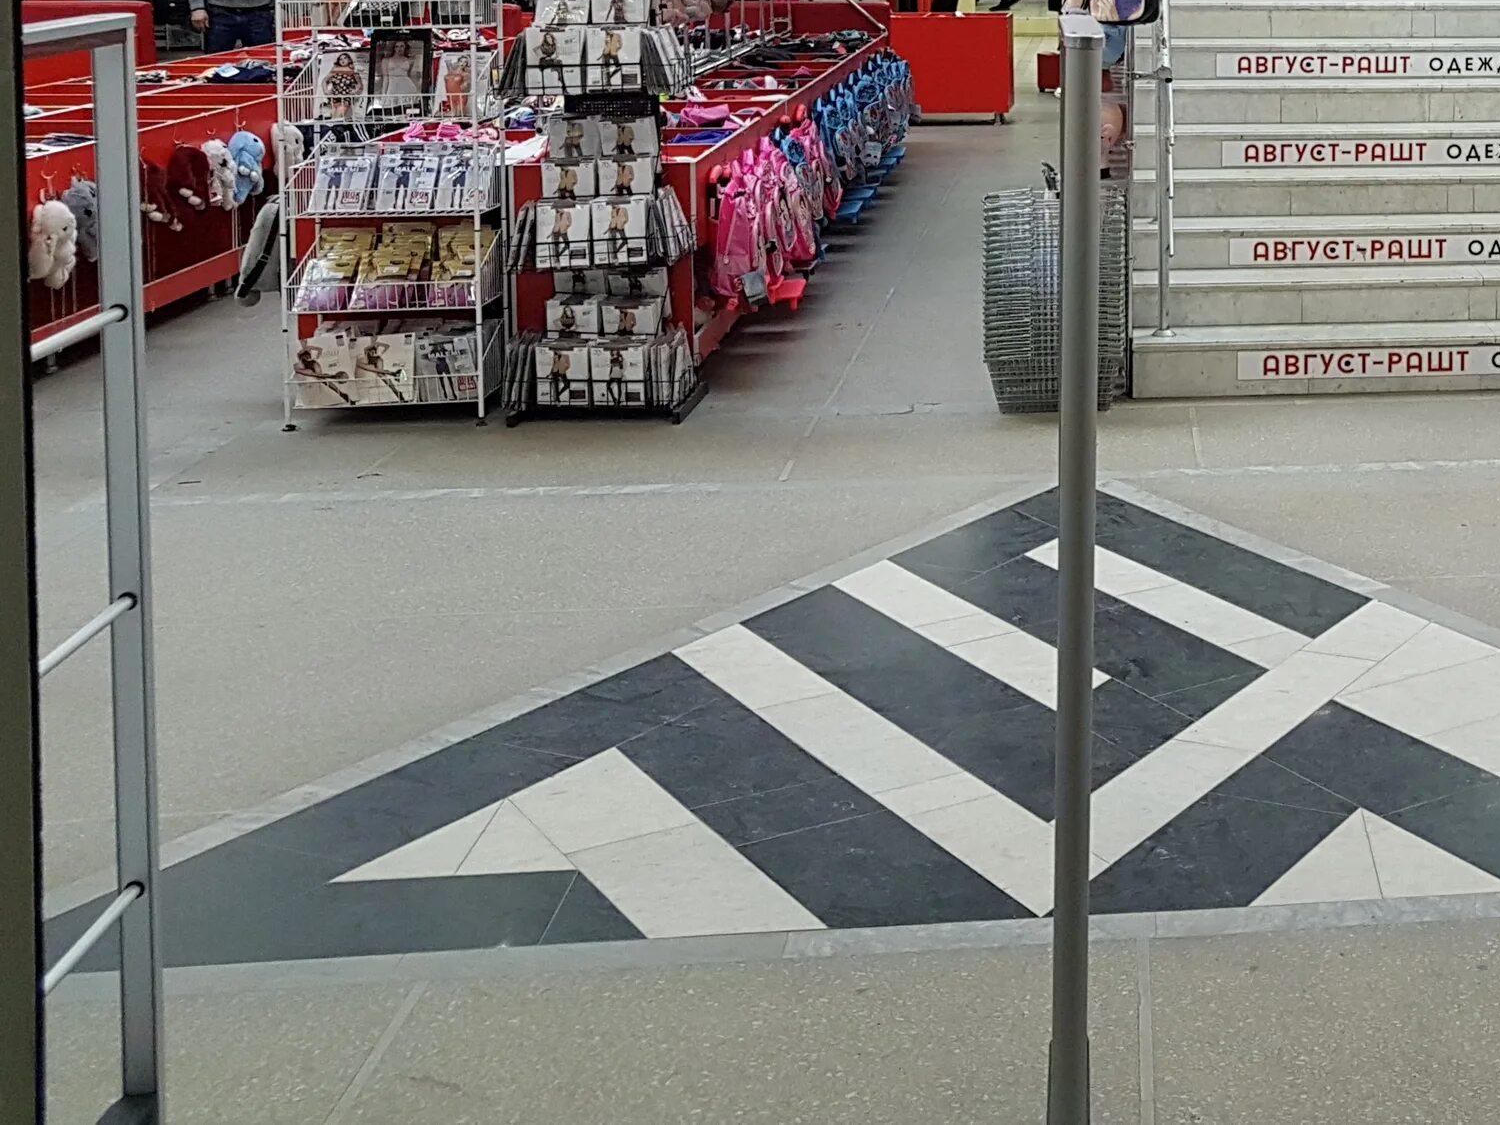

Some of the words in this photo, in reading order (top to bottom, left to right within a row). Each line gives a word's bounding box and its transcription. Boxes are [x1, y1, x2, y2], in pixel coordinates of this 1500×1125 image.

[1238, 56, 1410, 74] АВГУСТ-РАШТ
[1244, 142, 1427, 163] АВГУСТ-РАШТ
[1253, 239, 1447, 261] АВГУСТ-РАШТ
[1263, 350, 1469, 375] АВГУСТ-РАШТ
